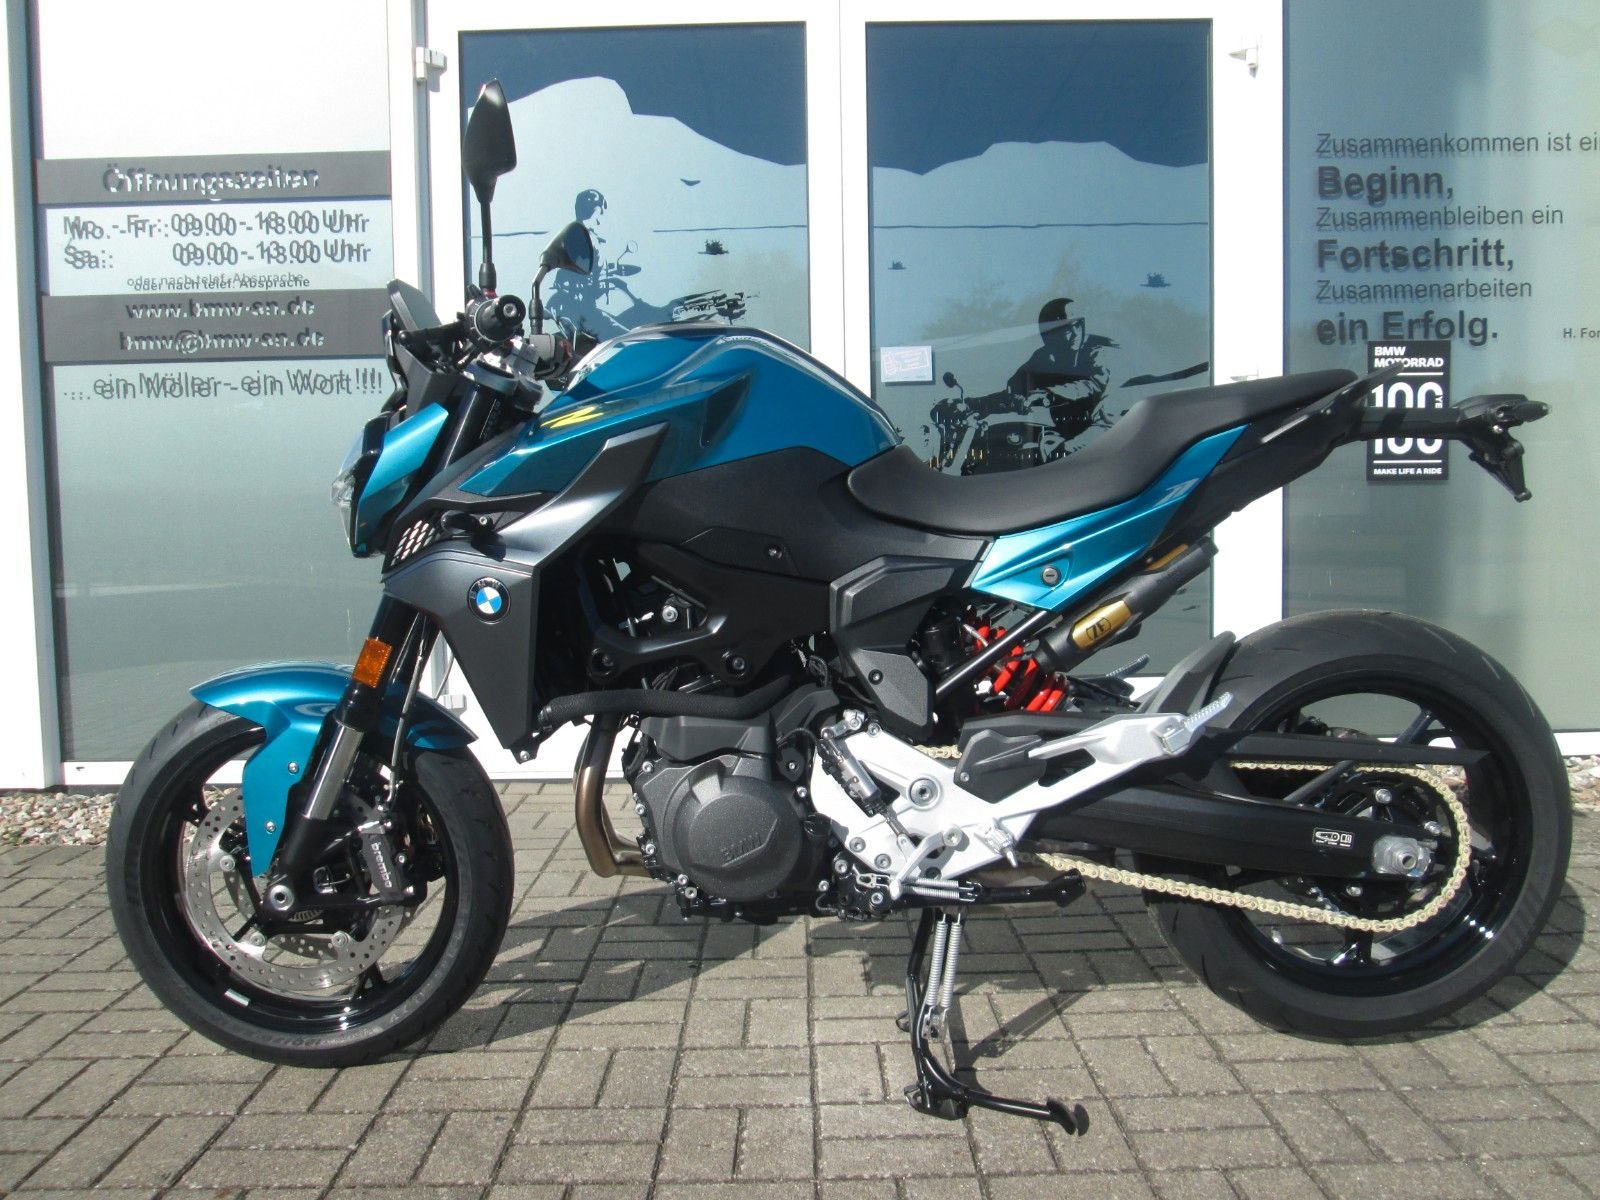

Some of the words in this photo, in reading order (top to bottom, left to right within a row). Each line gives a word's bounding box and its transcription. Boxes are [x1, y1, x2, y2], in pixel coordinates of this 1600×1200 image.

[1316, 133, 1539, 154] Zusammenkommen
[1547, 132, 1572, 152] ist
[1579, 131, 1600, 151] ei
[102, 163, 319, 197] Öffnungszeiten
[1317, 166, 1454, 204] Beginn,
[63, 215, 111, 240] Mo.
[171, 211, 236, 237] 09.00
[255, 210, 320, 235] 18.00
[322, 208, 370, 234] Uhr
[1316, 206, 1524, 228] Zusammenbleiben
[1532, 204, 1563, 225] ein
[172, 242, 239, 267] 09.00
[256, 240, 322, 265] 13.00
[323, 238, 371, 263] Uhr
[1317, 238, 1514, 271] Fortschritt,
[127, 275, 162, 291] oder
[160, 274, 199, 290] nach
[232, 271, 310, 290] Absprache
[1316, 279, 1533, 300] Zusammenarbeiten
[126, 296, 315, 319] www.bmw-sn.de
[119, 327, 325, 354] bmw@bmw-sn.de
[1316, 312, 1369, 343] ein
[1382, 310, 1498, 346] Erfolg.
[1563, 327, 1576, 339] H.
[1374, 346, 1406, 356] BMW
[93, 373, 136, 399] ein
[139, 372, 222, 398] Möller
[241, 370, 283, 396] ein
[286, 369, 352, 395] Wort
[371, 841, 392, 888] brembo
